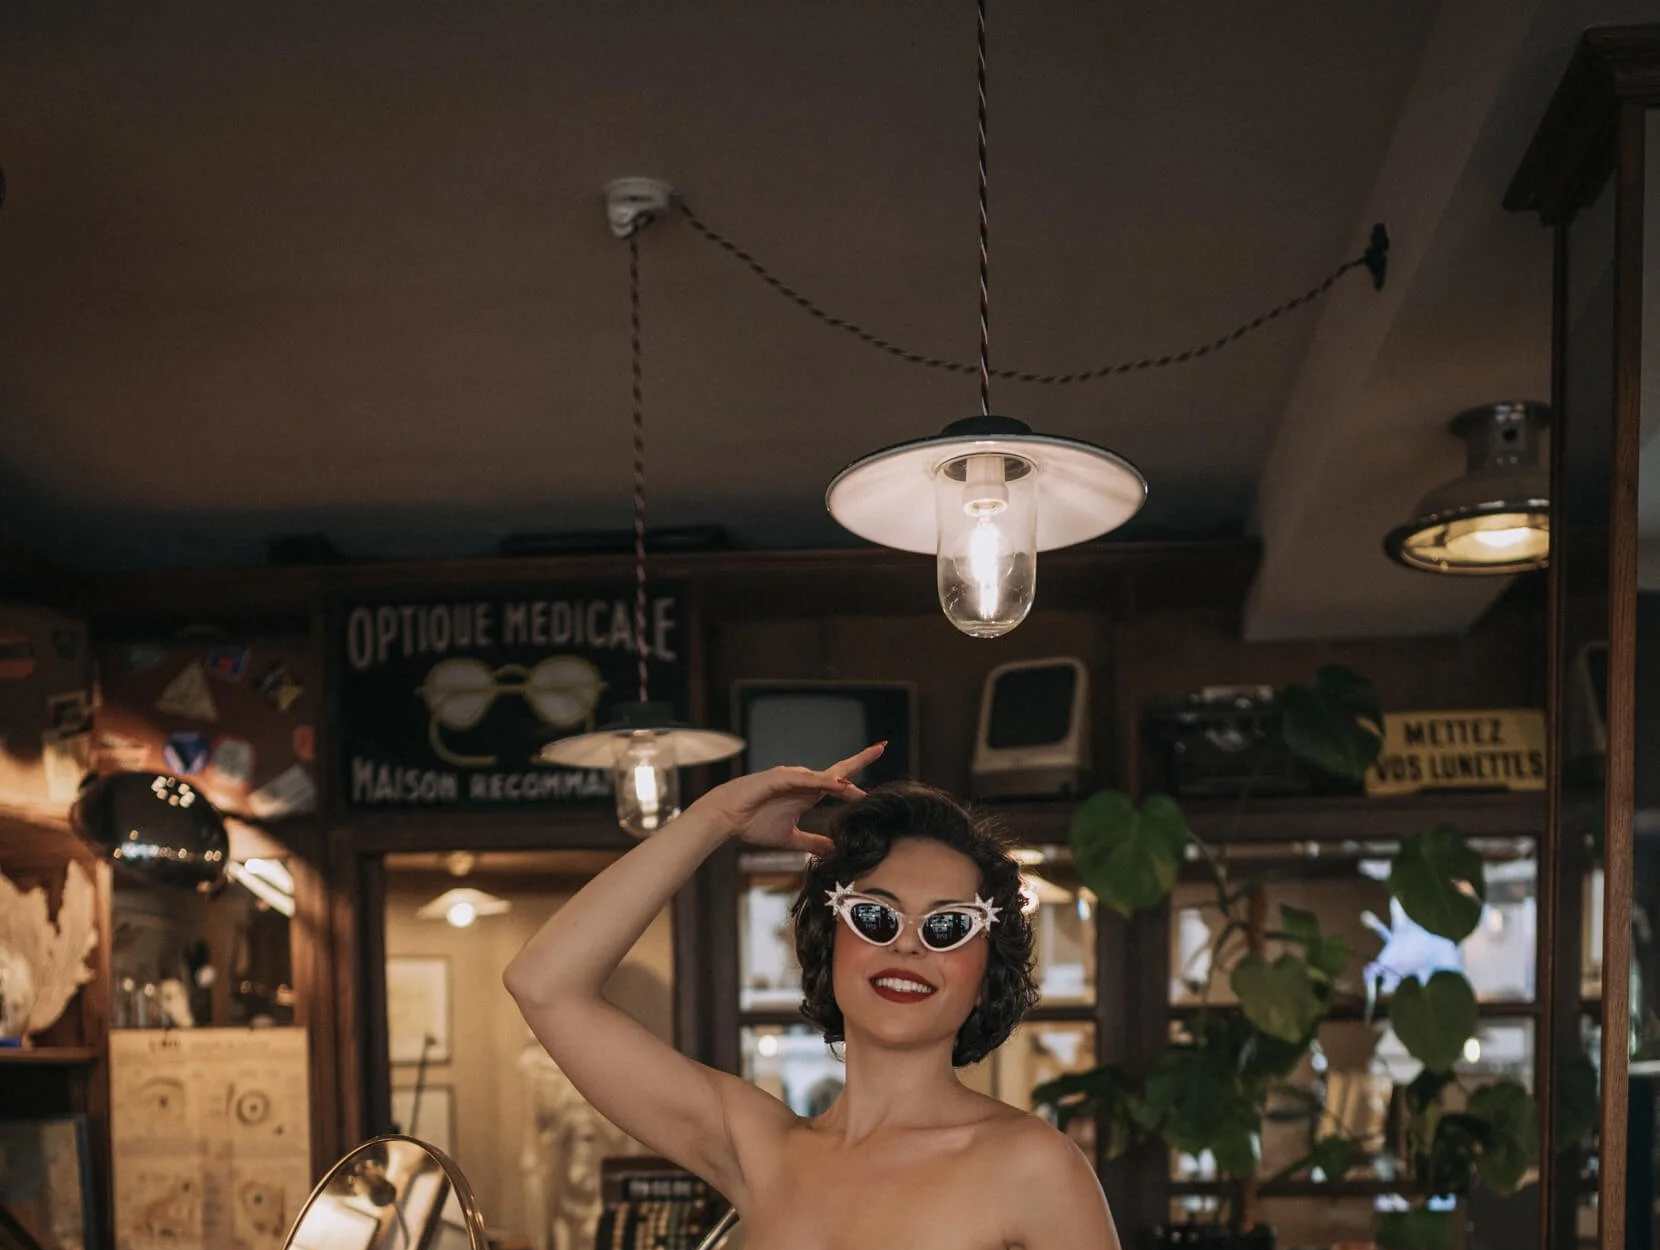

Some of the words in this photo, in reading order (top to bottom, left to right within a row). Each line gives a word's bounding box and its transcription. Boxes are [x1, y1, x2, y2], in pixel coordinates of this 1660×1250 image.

[348, 603, 492, 669] OPTIQUE
[1404, 719, 1504, 747] METTEZ
[351, 756, 458, 802] MAISON
[1430, 750, 1544, 780] LUNETTES
